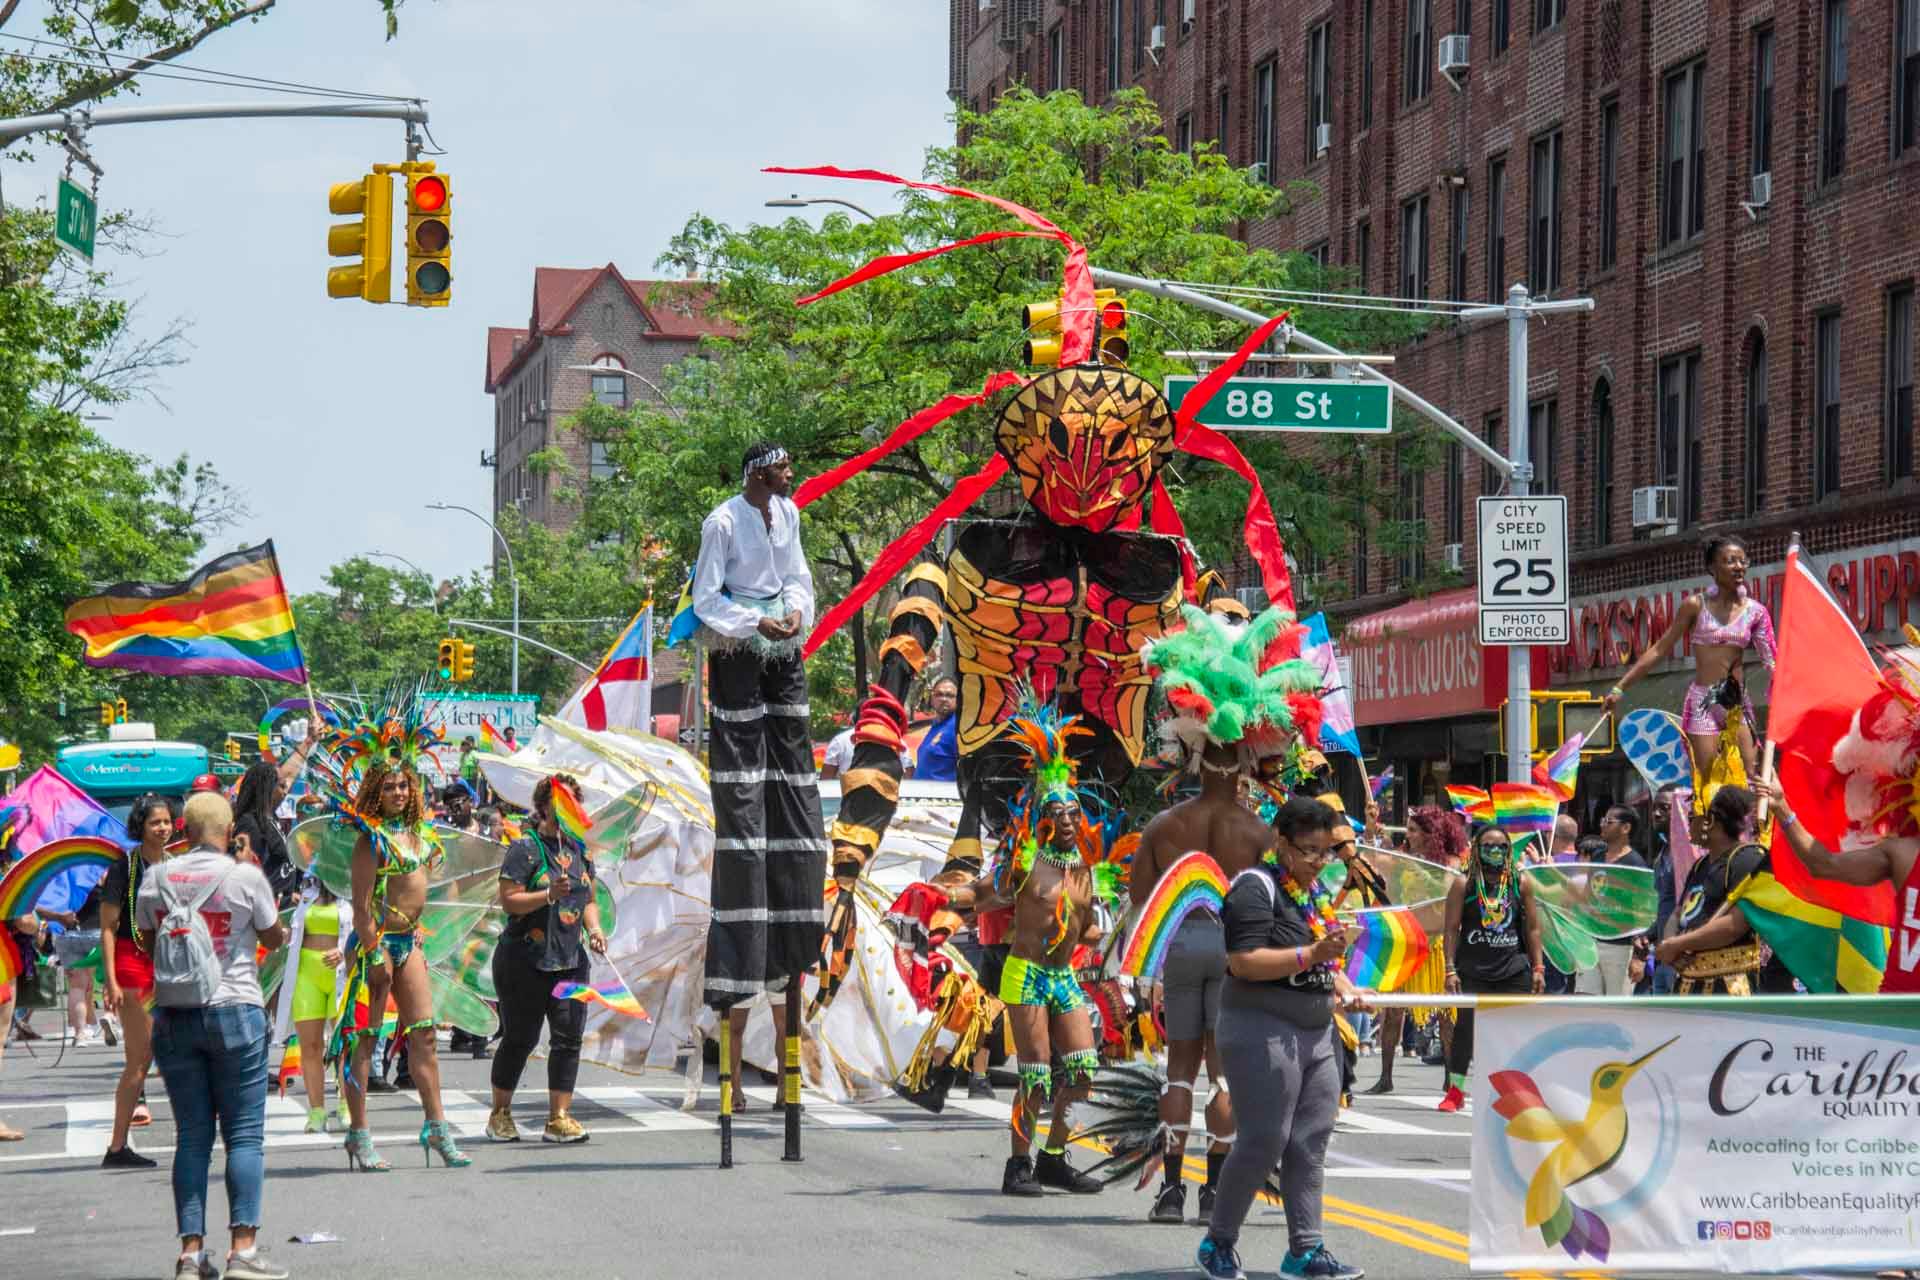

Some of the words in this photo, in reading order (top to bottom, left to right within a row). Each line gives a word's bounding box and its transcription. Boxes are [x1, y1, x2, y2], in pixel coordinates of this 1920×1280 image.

[1226, 390, 1273, 418] 88
[1295, 391, 1332, 420] St
[1503, 505, 1538, 518] CITY
[1496, 522, 1546, 534] SPEED
[1502, 539, 1541, 551] LIMIT
[1492, 558, 1556, 597] 25
[1502, 614, 1546, 625] PHOTO
[1489, 626, 1560, 638] ENFORCED
[1388, 641, 1398, 699] &
[1402, 627, 1480, 698] LIQUORS
[1795, 1047, 1826, 1061] THE
[1823, 1102, 1910, 1119] EQUALITY
[1707, 1138, 1810, 1157] Advocating
[1816, 1138, 1839, 1153] for
[1792, 1161, 1854, 1177] Voices
[1859, 1161, 1875, 1176] in
[1880, 1161, 1920, 1176] NYC
